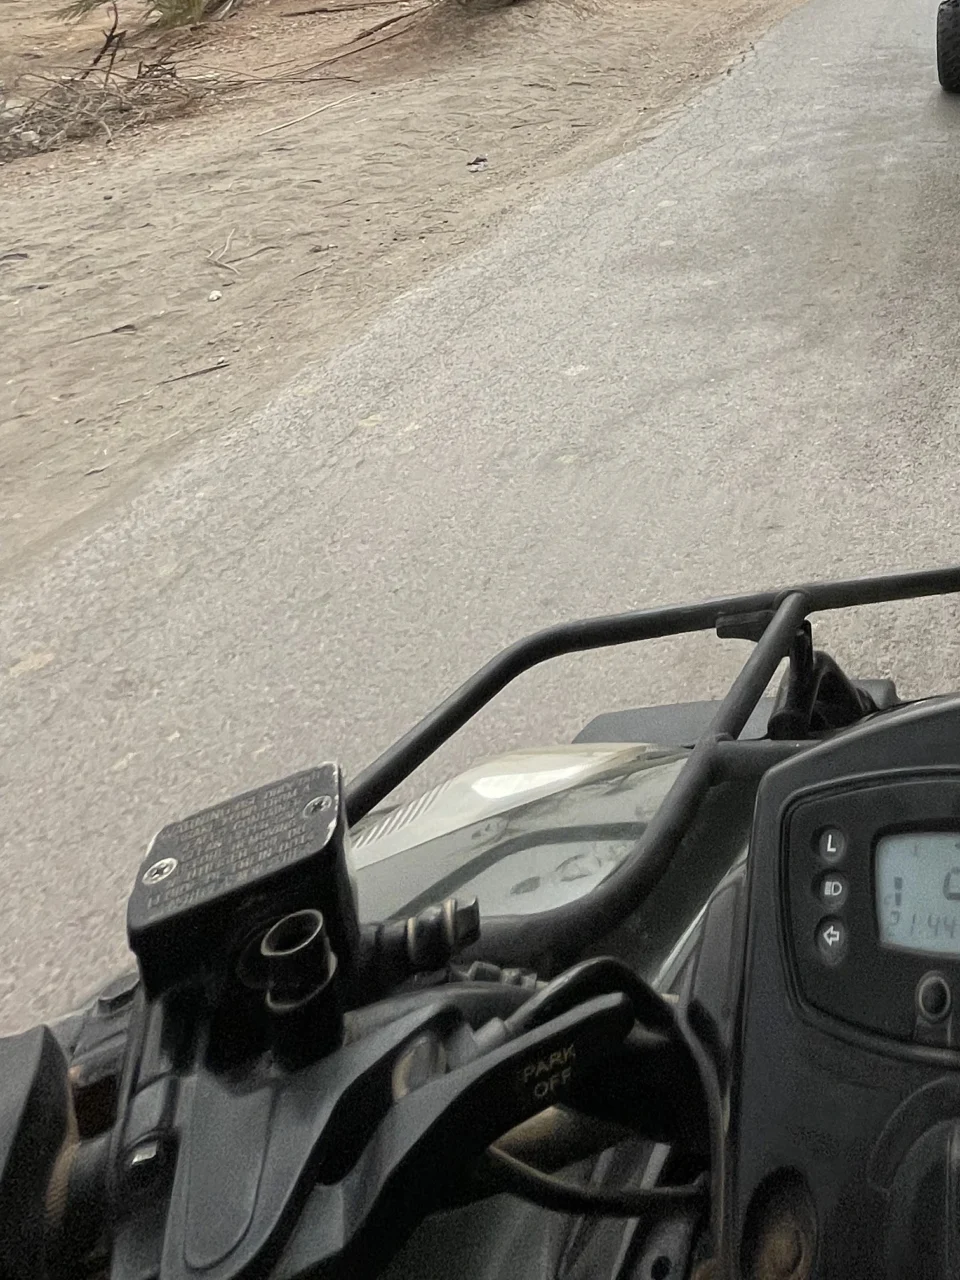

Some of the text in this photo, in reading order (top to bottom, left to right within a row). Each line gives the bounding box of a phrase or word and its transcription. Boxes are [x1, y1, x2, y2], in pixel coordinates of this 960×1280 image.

[826, 834, 837, 853] L
[522, 1043, 577, 1083] PARK
[533, 1067, 574, 1098] OFF
